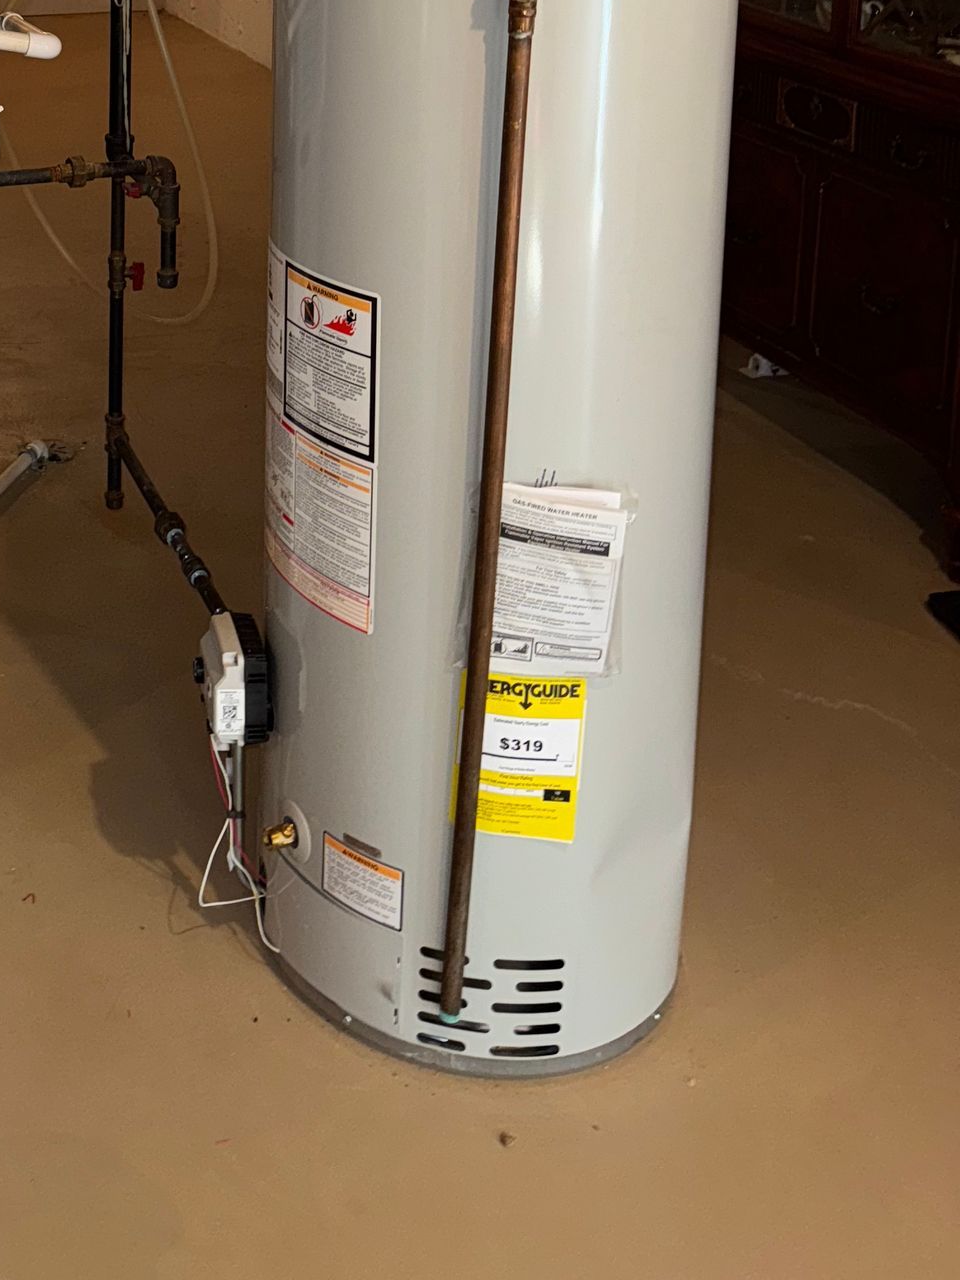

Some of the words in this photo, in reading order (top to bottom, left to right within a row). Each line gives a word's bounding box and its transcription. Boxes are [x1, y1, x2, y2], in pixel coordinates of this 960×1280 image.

[313, 283, 339, 301] WARNING
[547, 506, 570, 516] WATER
[571, 510, 598, 520] HEATER
[489, 679, 581, 702] ERGYGUIDE
[499, 737, 544, 752] $319
[346, 851, 379, 871] WARNING
